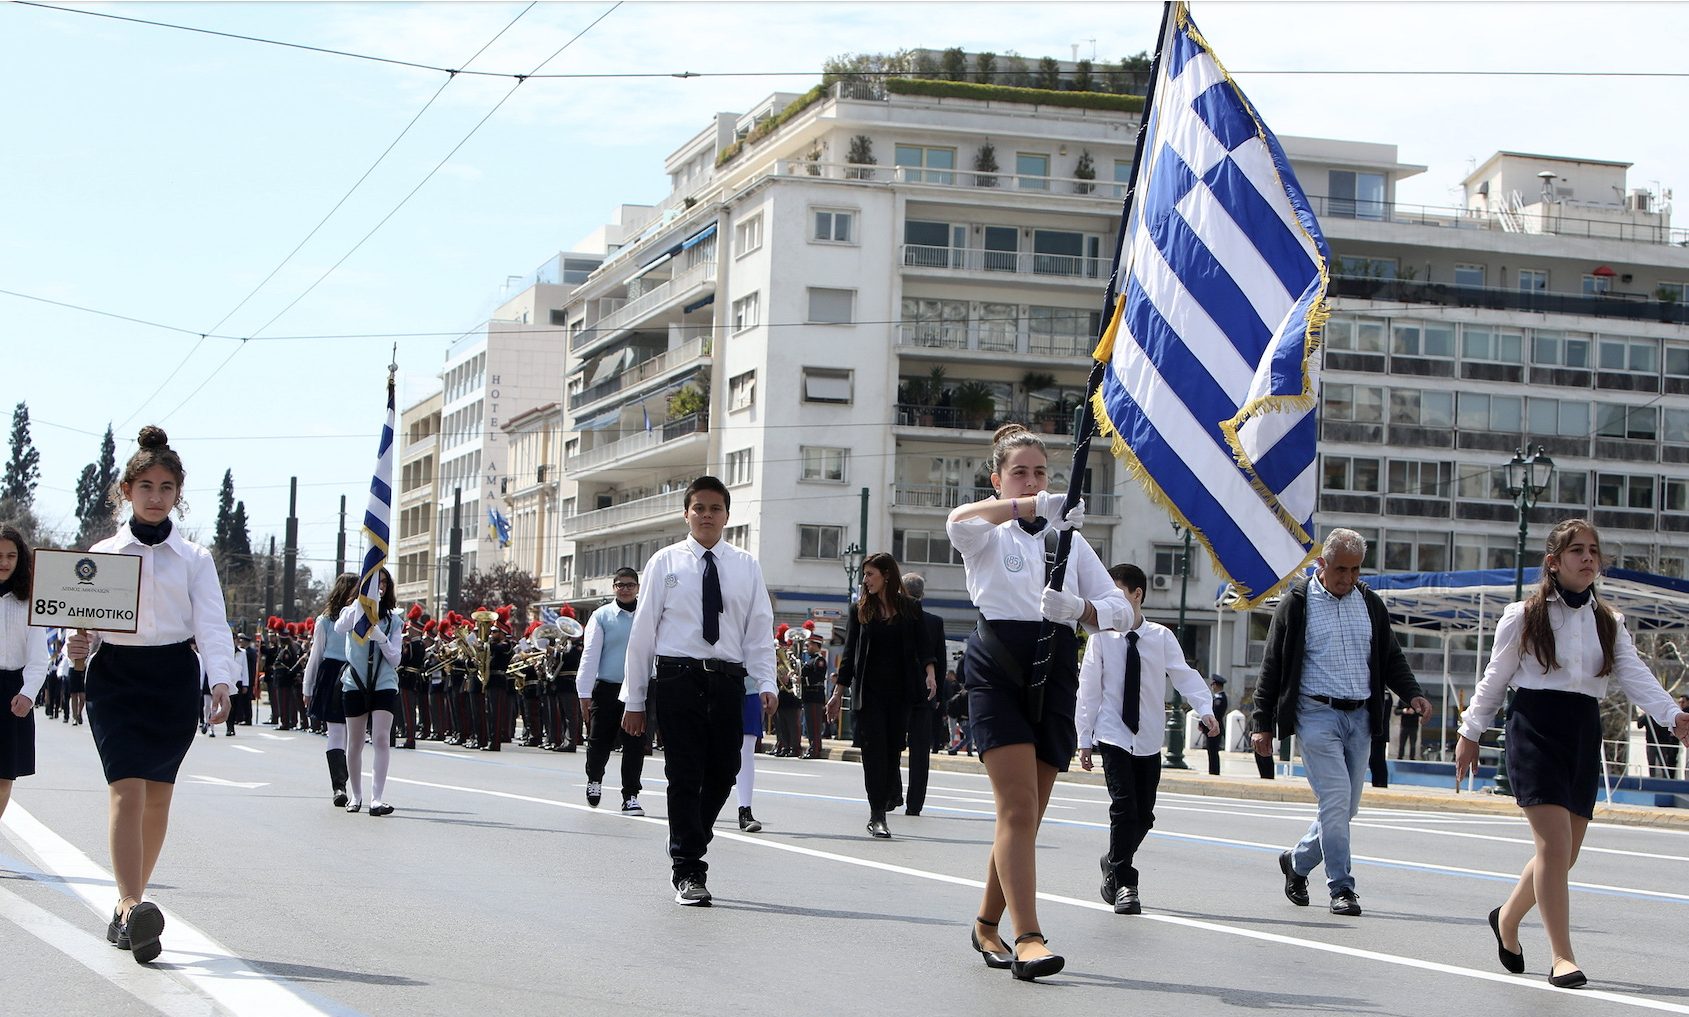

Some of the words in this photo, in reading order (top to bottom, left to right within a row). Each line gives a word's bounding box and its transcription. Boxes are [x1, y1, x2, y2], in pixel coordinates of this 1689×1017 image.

[490, 375, 501, 441] HOTEL
[485, 462, 497, 543] AMAA
[68, 607, 134, 620] ΔΗΜΟΤΙΚΟ
